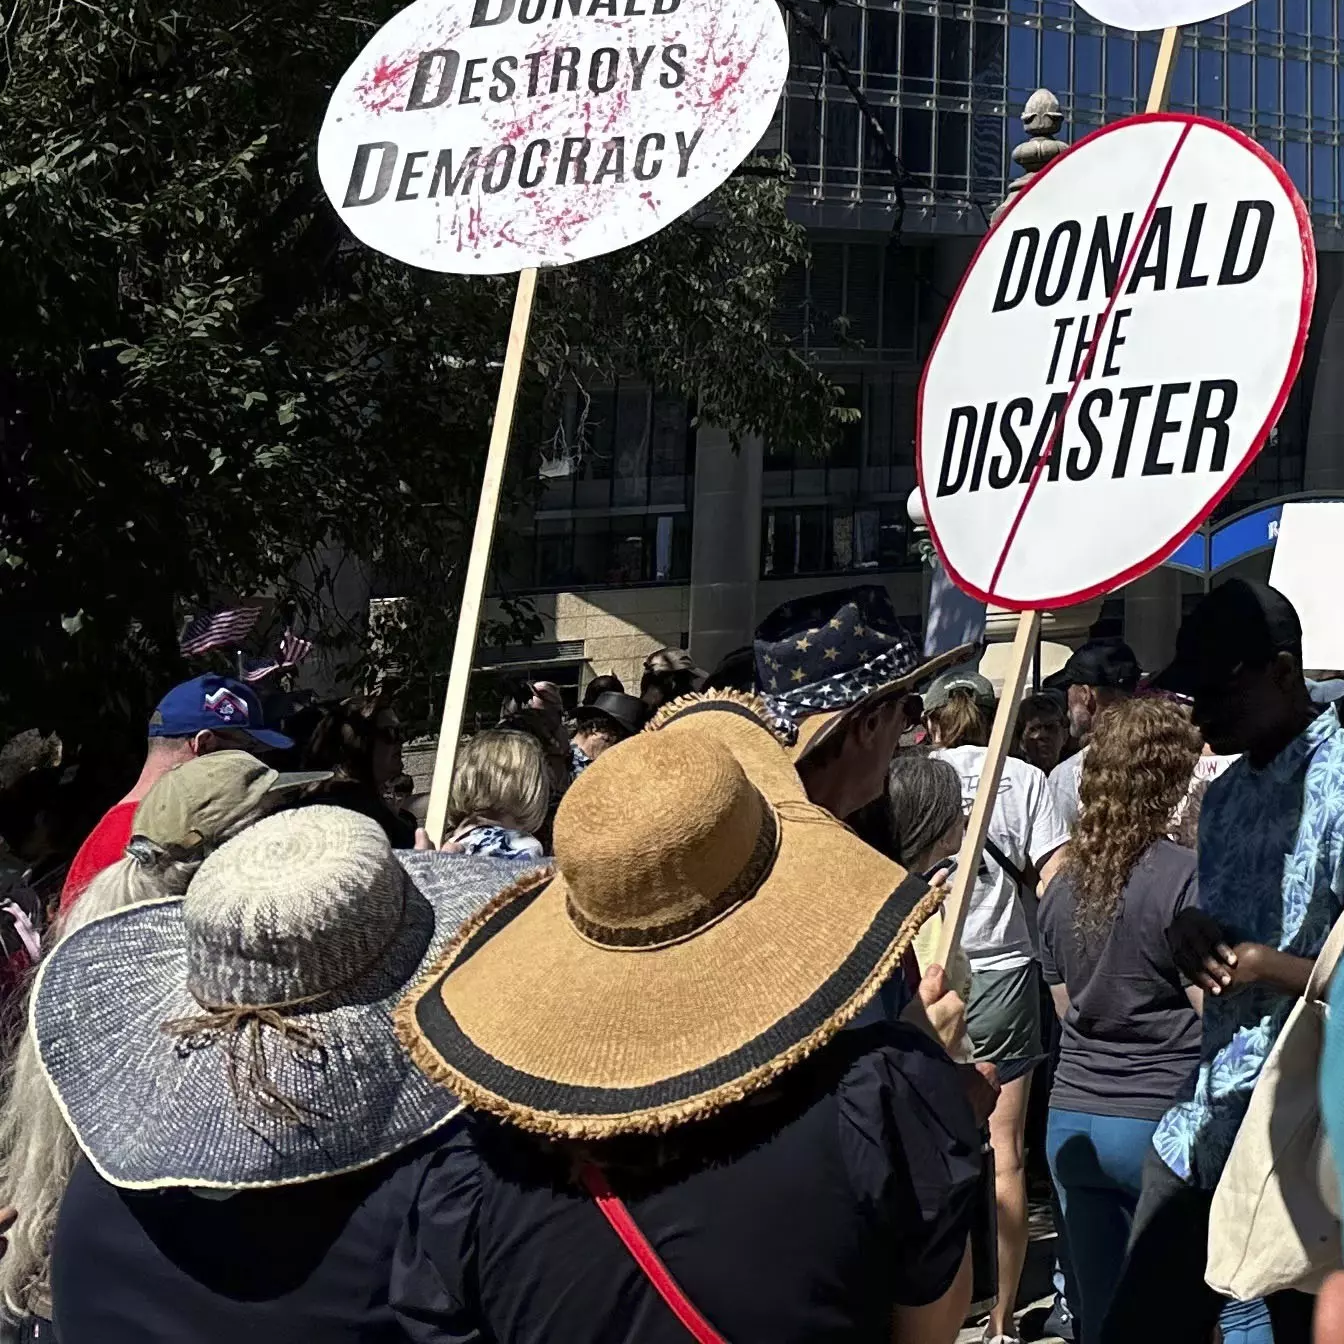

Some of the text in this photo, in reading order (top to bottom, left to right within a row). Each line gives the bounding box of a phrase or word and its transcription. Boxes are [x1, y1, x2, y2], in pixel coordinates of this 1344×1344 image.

[404, 42, 688, 112] DESTROYS
[342, 128, 707, 208] DEMOCRACY
[992, 199, 1276, 313] DONALD
[1046, 311, 1128, 385] THE
[937, 378, 1238, 498] DISASTER
